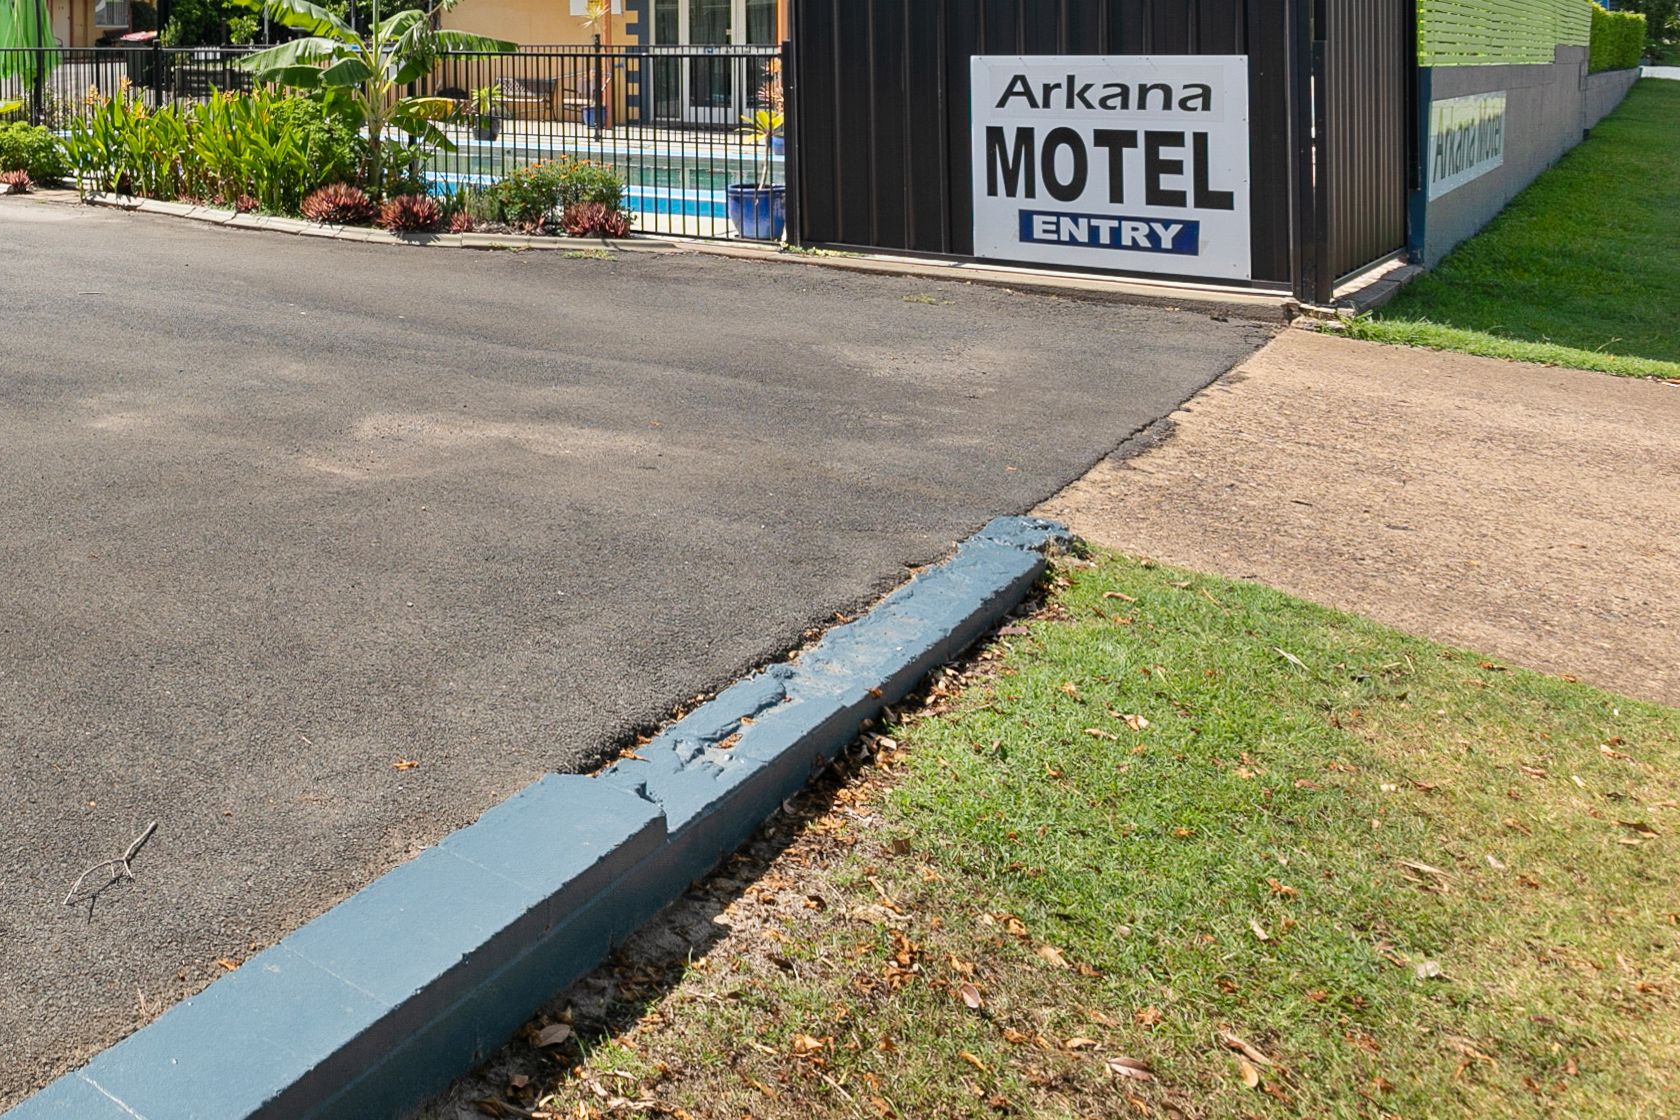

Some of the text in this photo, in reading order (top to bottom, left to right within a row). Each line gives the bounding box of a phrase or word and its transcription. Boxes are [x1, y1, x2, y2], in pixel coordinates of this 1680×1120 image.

[995, 74, 1213, 112] Arkana
[985, 126, 1235, 211] MOTEL
[1433, 106, 1476, 183] Arkana
[1032, 214, 1184, 249] ENTRY
